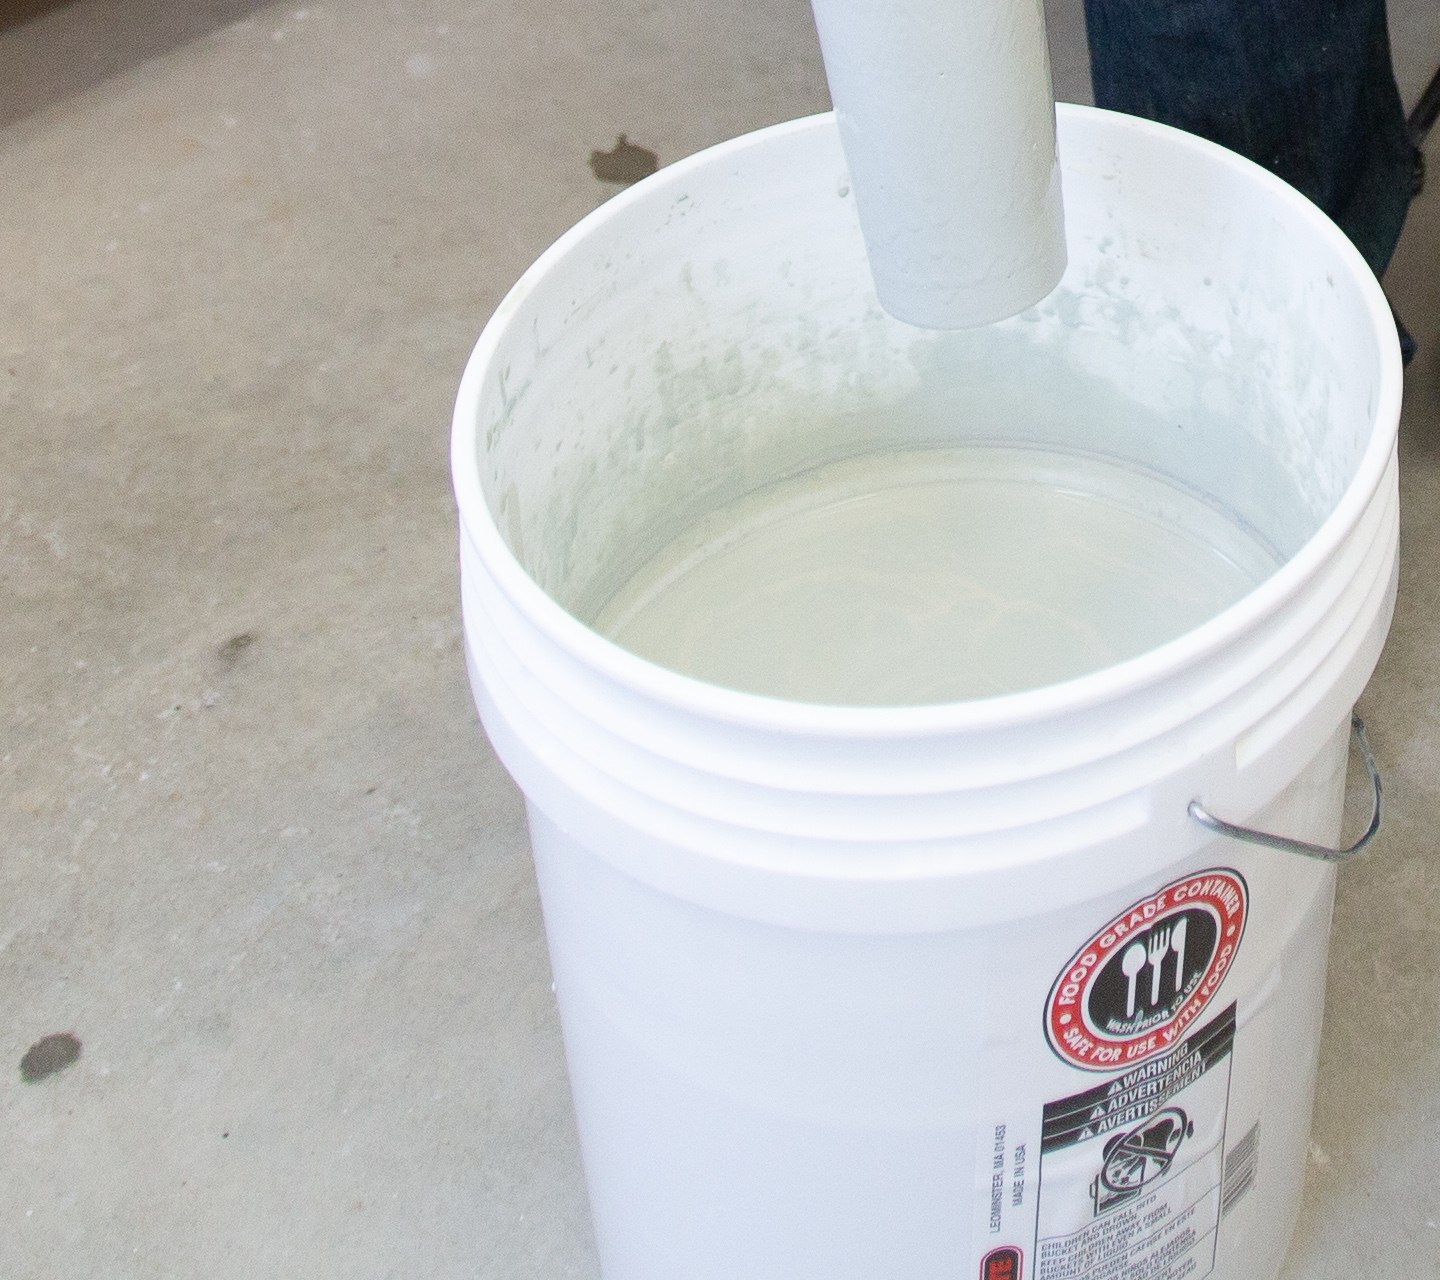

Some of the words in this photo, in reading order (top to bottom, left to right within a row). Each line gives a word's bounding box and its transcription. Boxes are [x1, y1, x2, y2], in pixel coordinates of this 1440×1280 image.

[1060, 952, 1098, 1005] FOOD
[1099, 895, 1167, 948] GRADE
[1173, 878, 1240, 919] CONTAINER
[1063, 1027, 1095, 1057] SAFE
[1090, 1046, 1122, 1062] FOR
[1127, 1036, 1158, 1058] USE
[1162, 999, 1202, 1042] WITH
[1201, 944, 1233, 997] FOOD
[1105, 1018, 1135, 1034] WASH
[1134, 1009, 1170, 1034] PRIOR
[1170, 994, 1184, 1012] TO
[1183, 971, 1204, 994] USE
[1108, 1051, 1202, 1113] ADVERTENCIA
[1122, 1042, 1189, 1089] WARNING
[1097, 1061, 1208, 1133] AVERTISSEMENT
[993, 1153, 1005, 1169] MA
[1014, 1166, 1025, 1178] IN
[1015, 1143, 1026, 1166] USA
[1012, 1179, 1025, 1207] MADE
[1040, 1257, 1066, 1268] KEEP
[1068, 1235, 1114, 1263] CHILDREN
[1115, 1219, 1141, 1237] AWAY
[1143, 1202, 1168, 1222] FROM
[1041, 1231, 1090, 1251] CHILDREN
[1091, 1219, 1112, 1234] CAN
[1112, 1209, 1134, 1225] FALL
[1136, 1194, 1157, 1211] INTO
[1041, 1244, 1079, 1259] BUCKET
[1081, 1231, 1100, 1247] AND
[1040, 1256, 1084, 1275] BUCKETS
